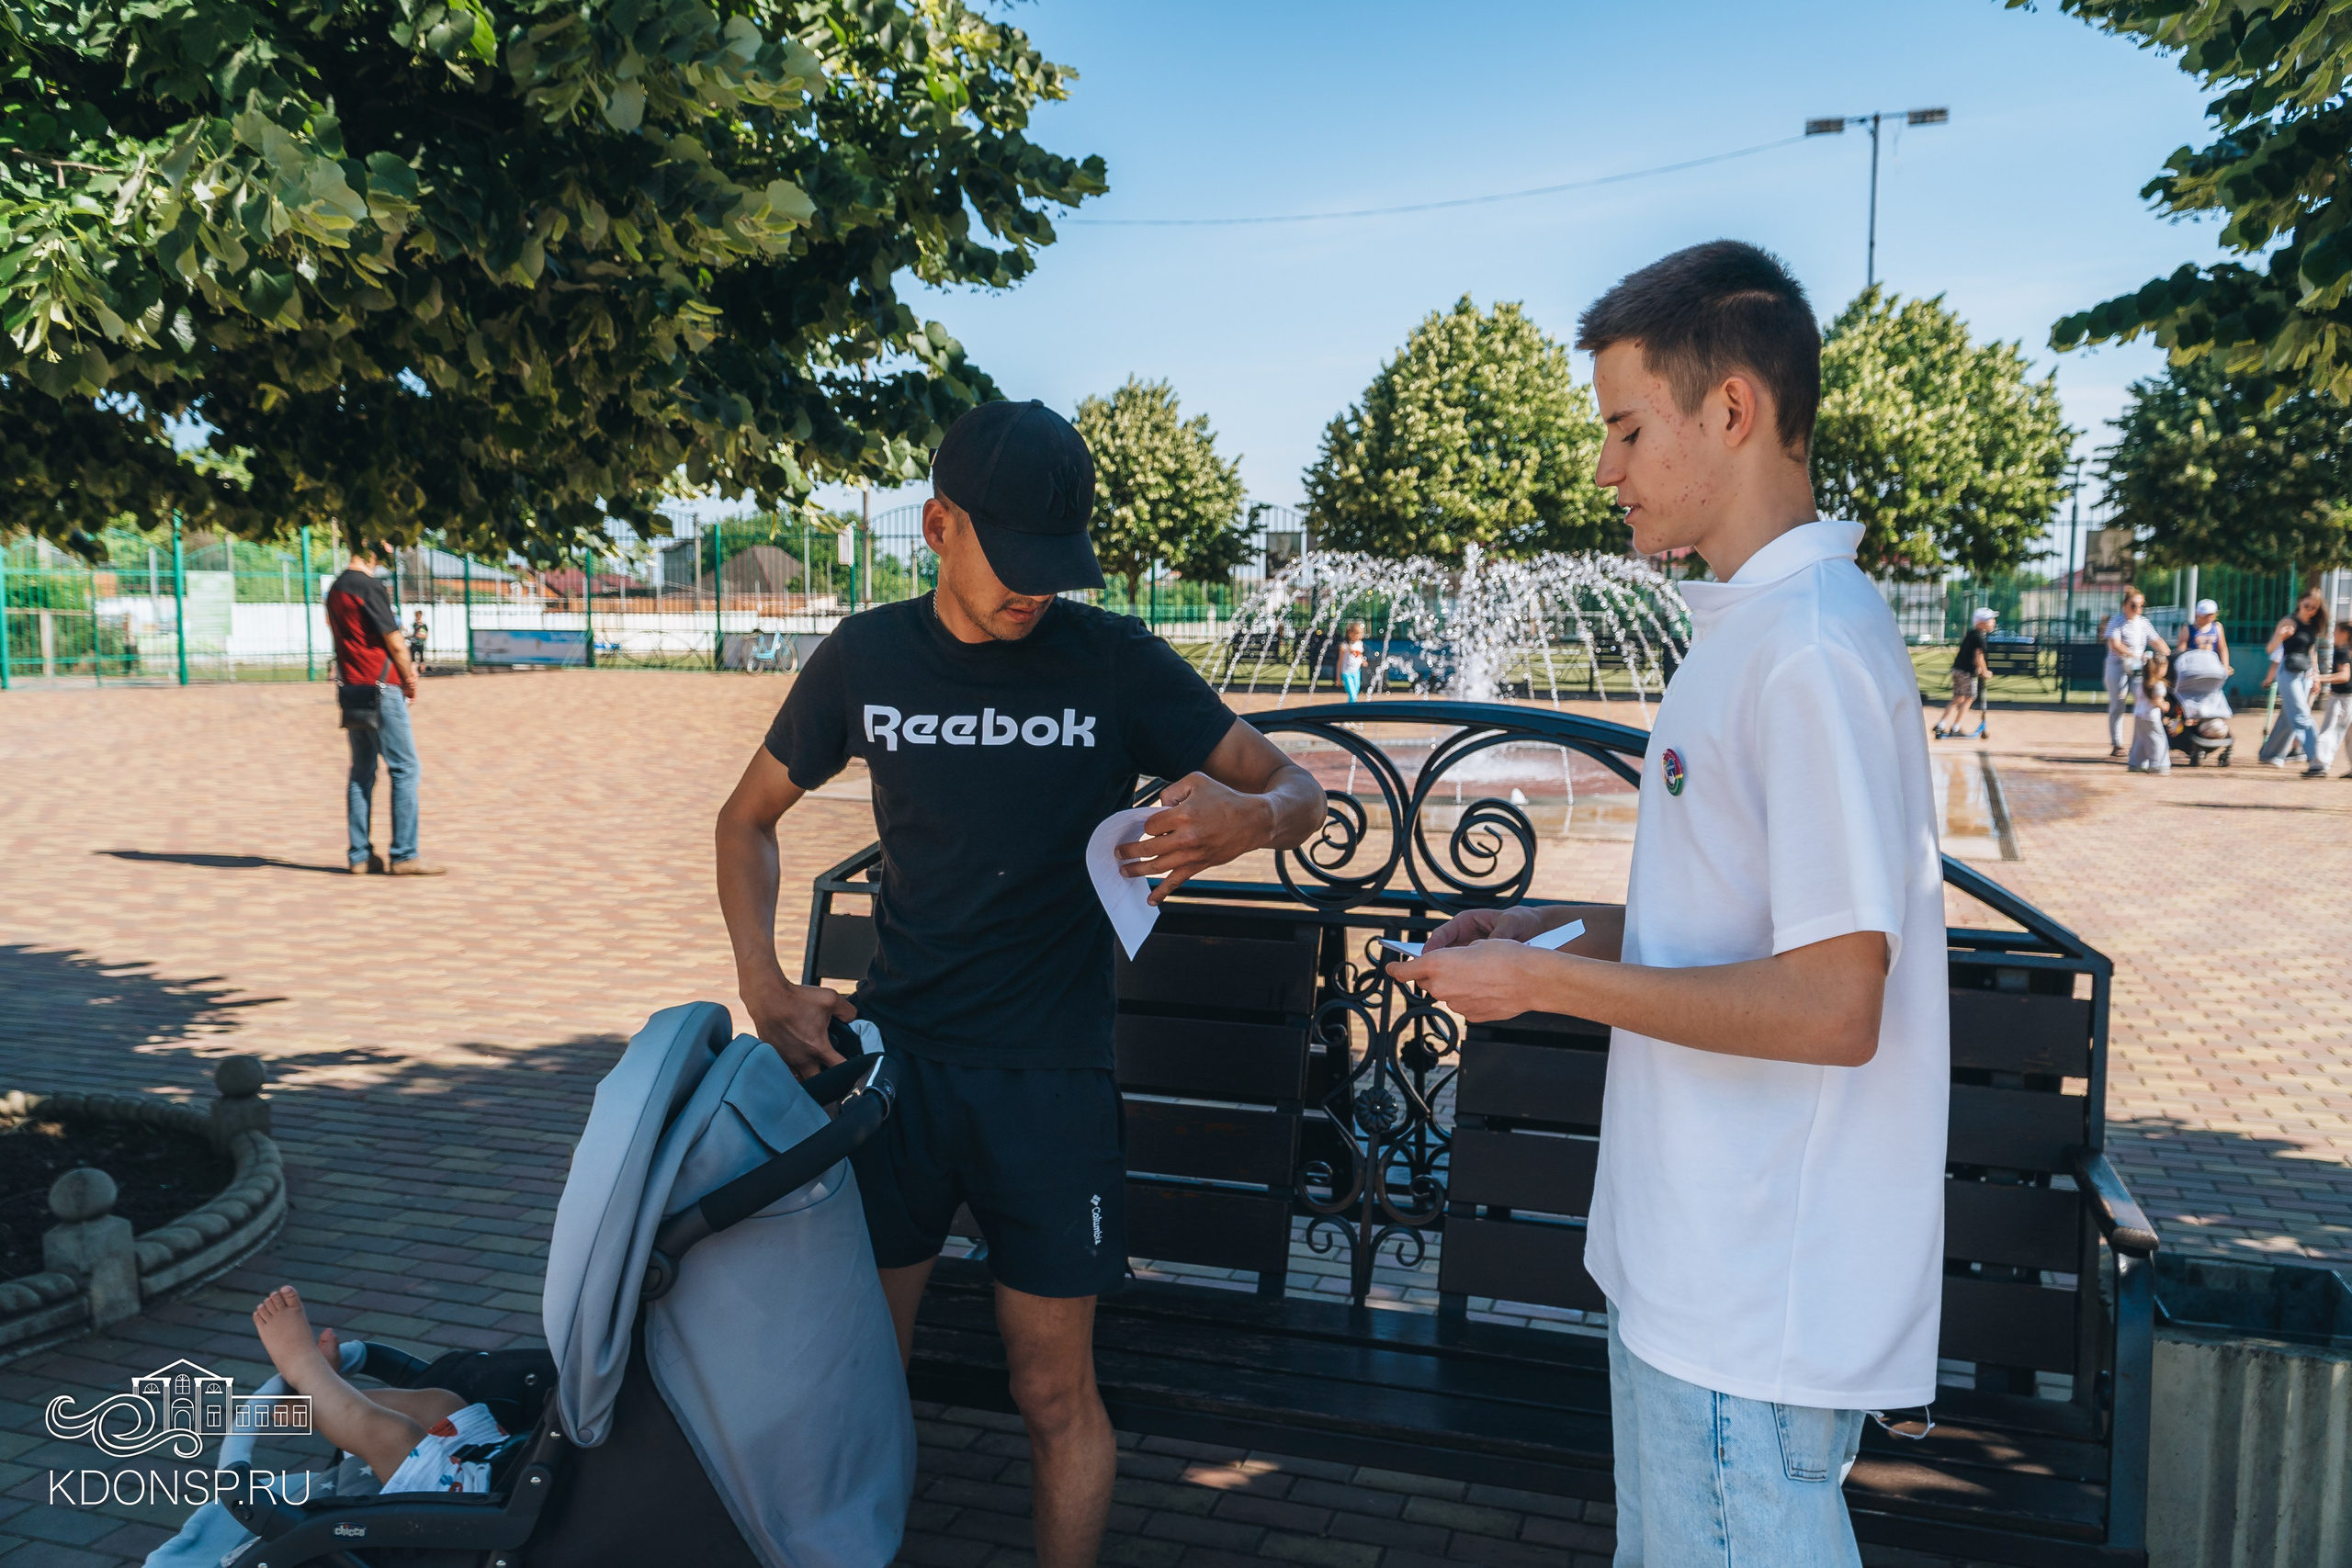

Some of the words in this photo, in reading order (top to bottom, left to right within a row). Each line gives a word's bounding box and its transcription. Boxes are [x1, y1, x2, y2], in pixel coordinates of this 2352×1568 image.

[864, 704, 1096, 751] Reebok
[1091, 1206, 1102, 1246] Columbia
[334, 1524, 366, 1537] chicco
